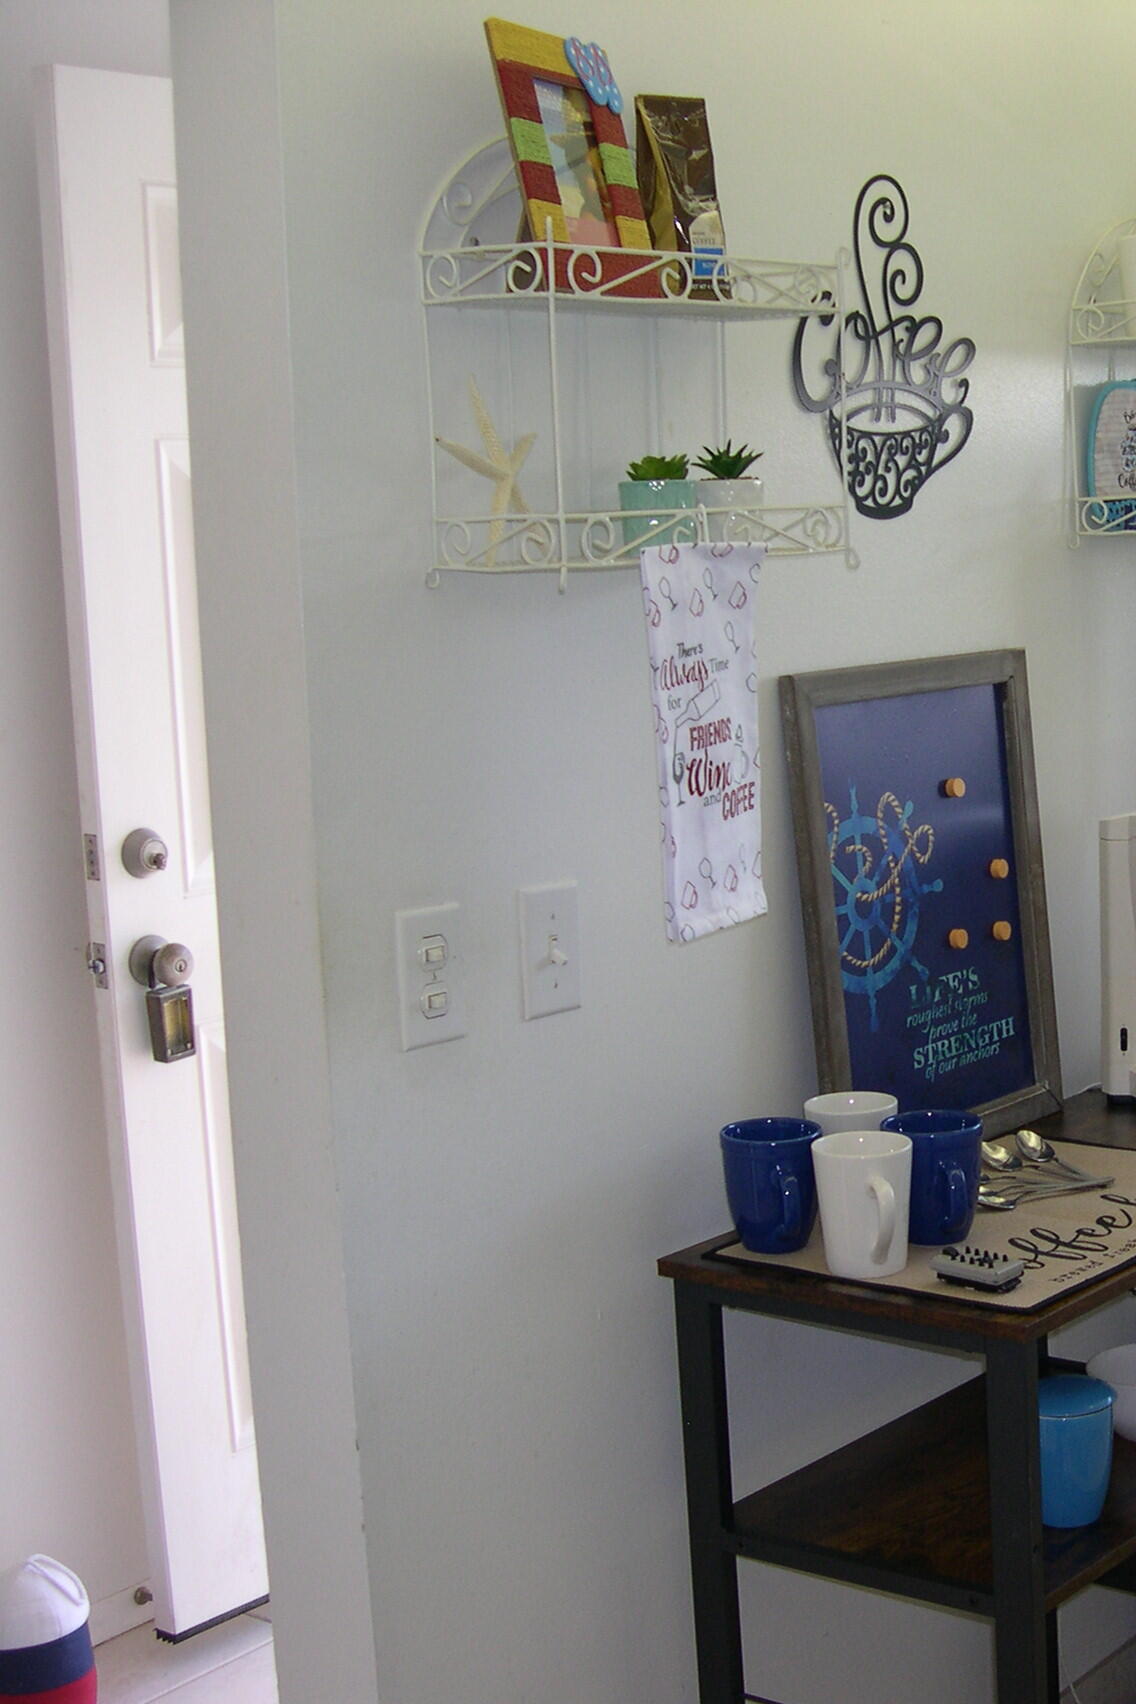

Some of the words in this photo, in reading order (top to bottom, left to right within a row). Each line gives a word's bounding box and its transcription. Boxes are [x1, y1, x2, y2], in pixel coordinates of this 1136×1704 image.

[689, 717, 732, 752] FRIENDS
[912, 1016, 1016, 1070] STRENGTH
[938, 1058, 958, 1074] our
